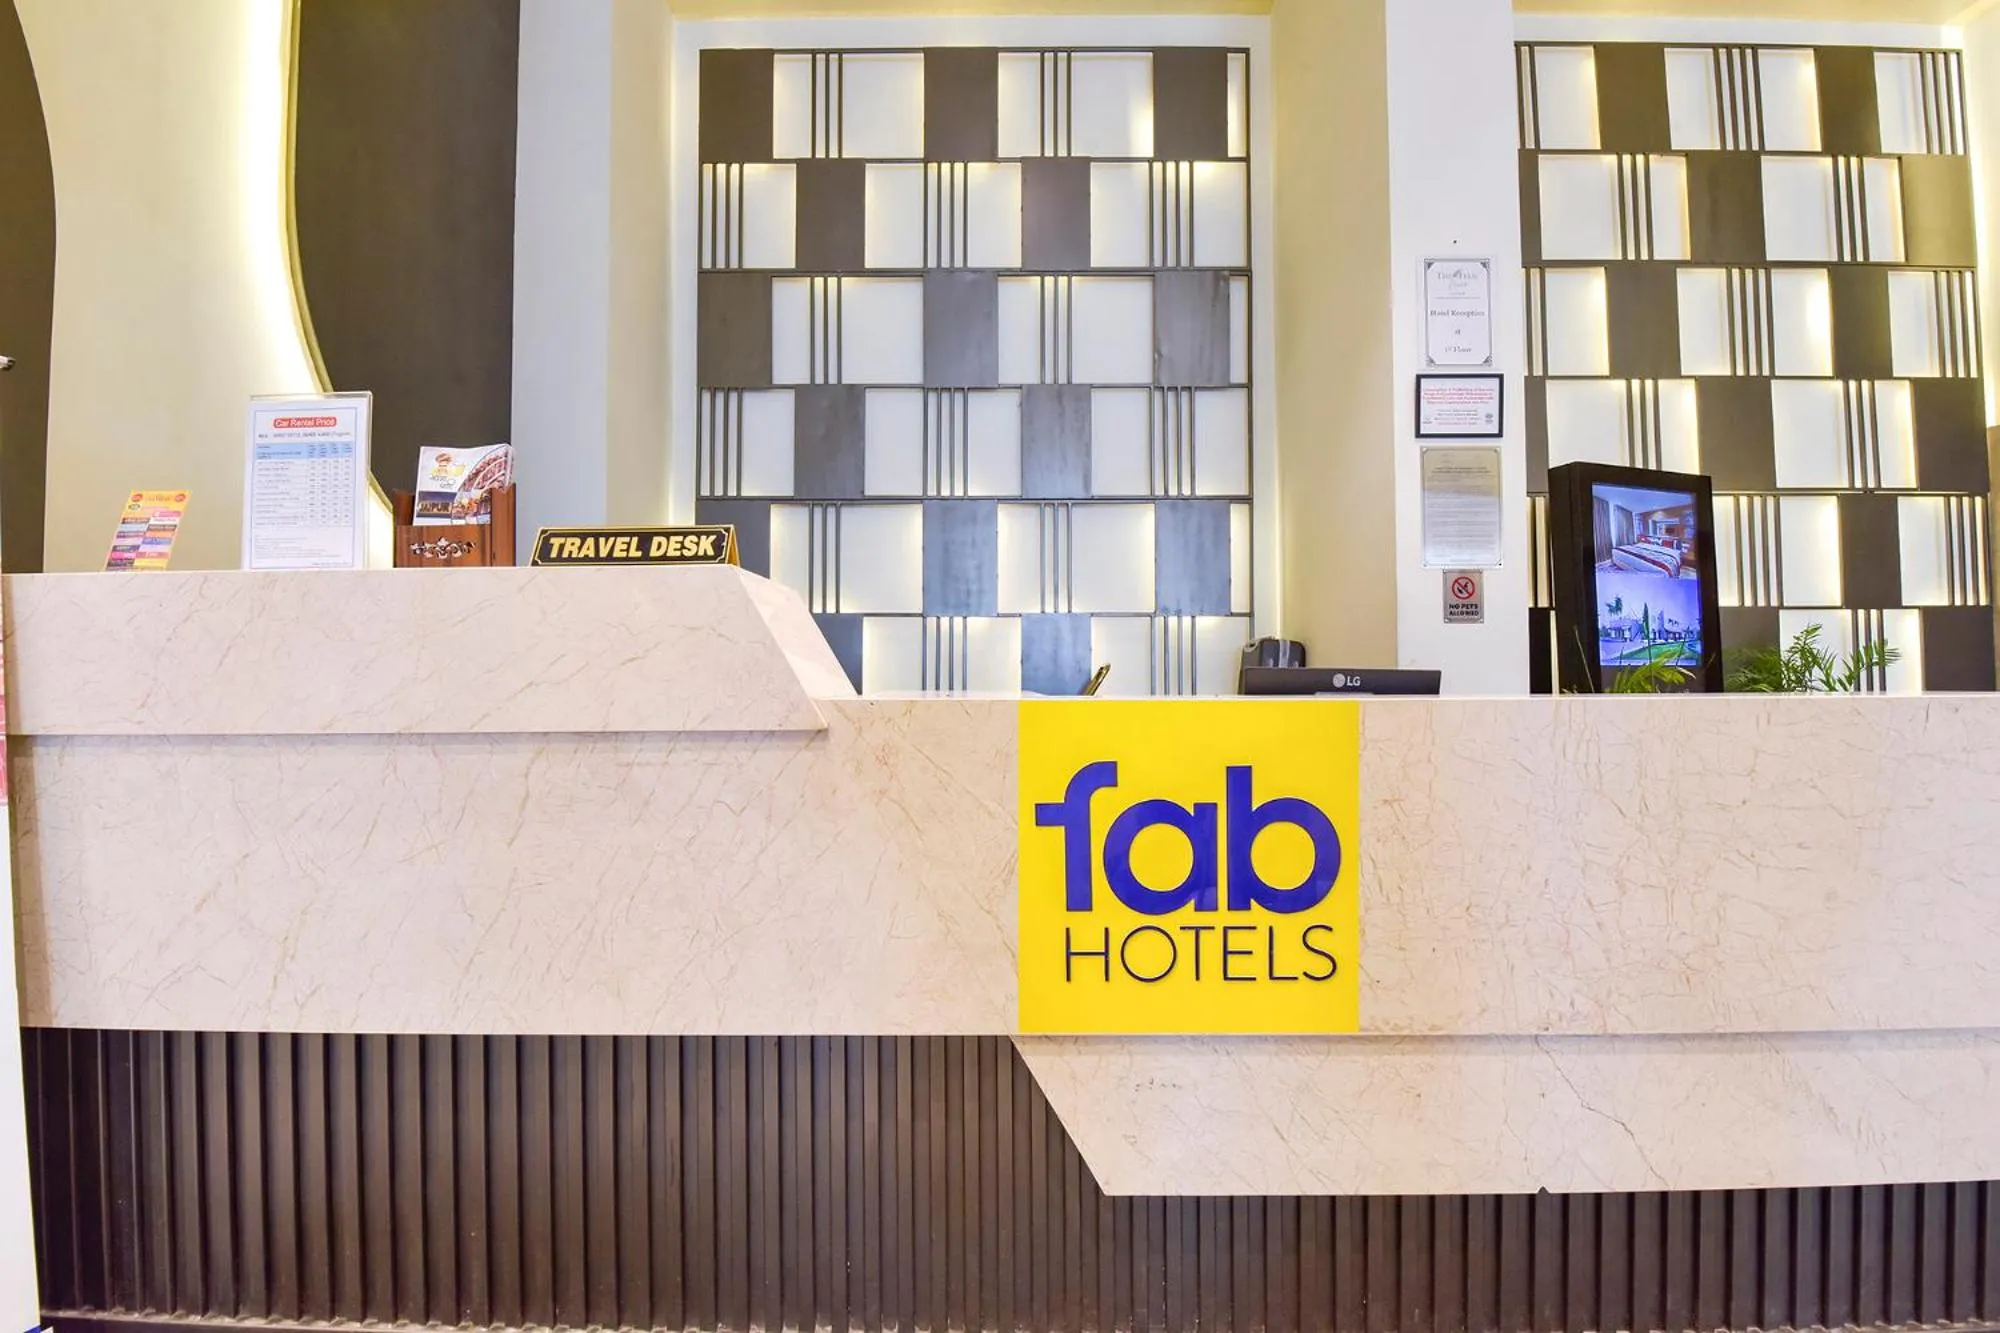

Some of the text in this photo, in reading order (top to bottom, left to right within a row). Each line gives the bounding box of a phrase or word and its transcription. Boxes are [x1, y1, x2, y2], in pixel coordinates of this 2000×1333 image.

[275, 416, 335, 428] Car Rental Price
[549, 535, 717, 558] TRAVEL DESK
[1346, 675, 1361, 687] LG
[1034, 760, 1342, 916] fab
[1065, 924, 1338, 983] HOTELS
